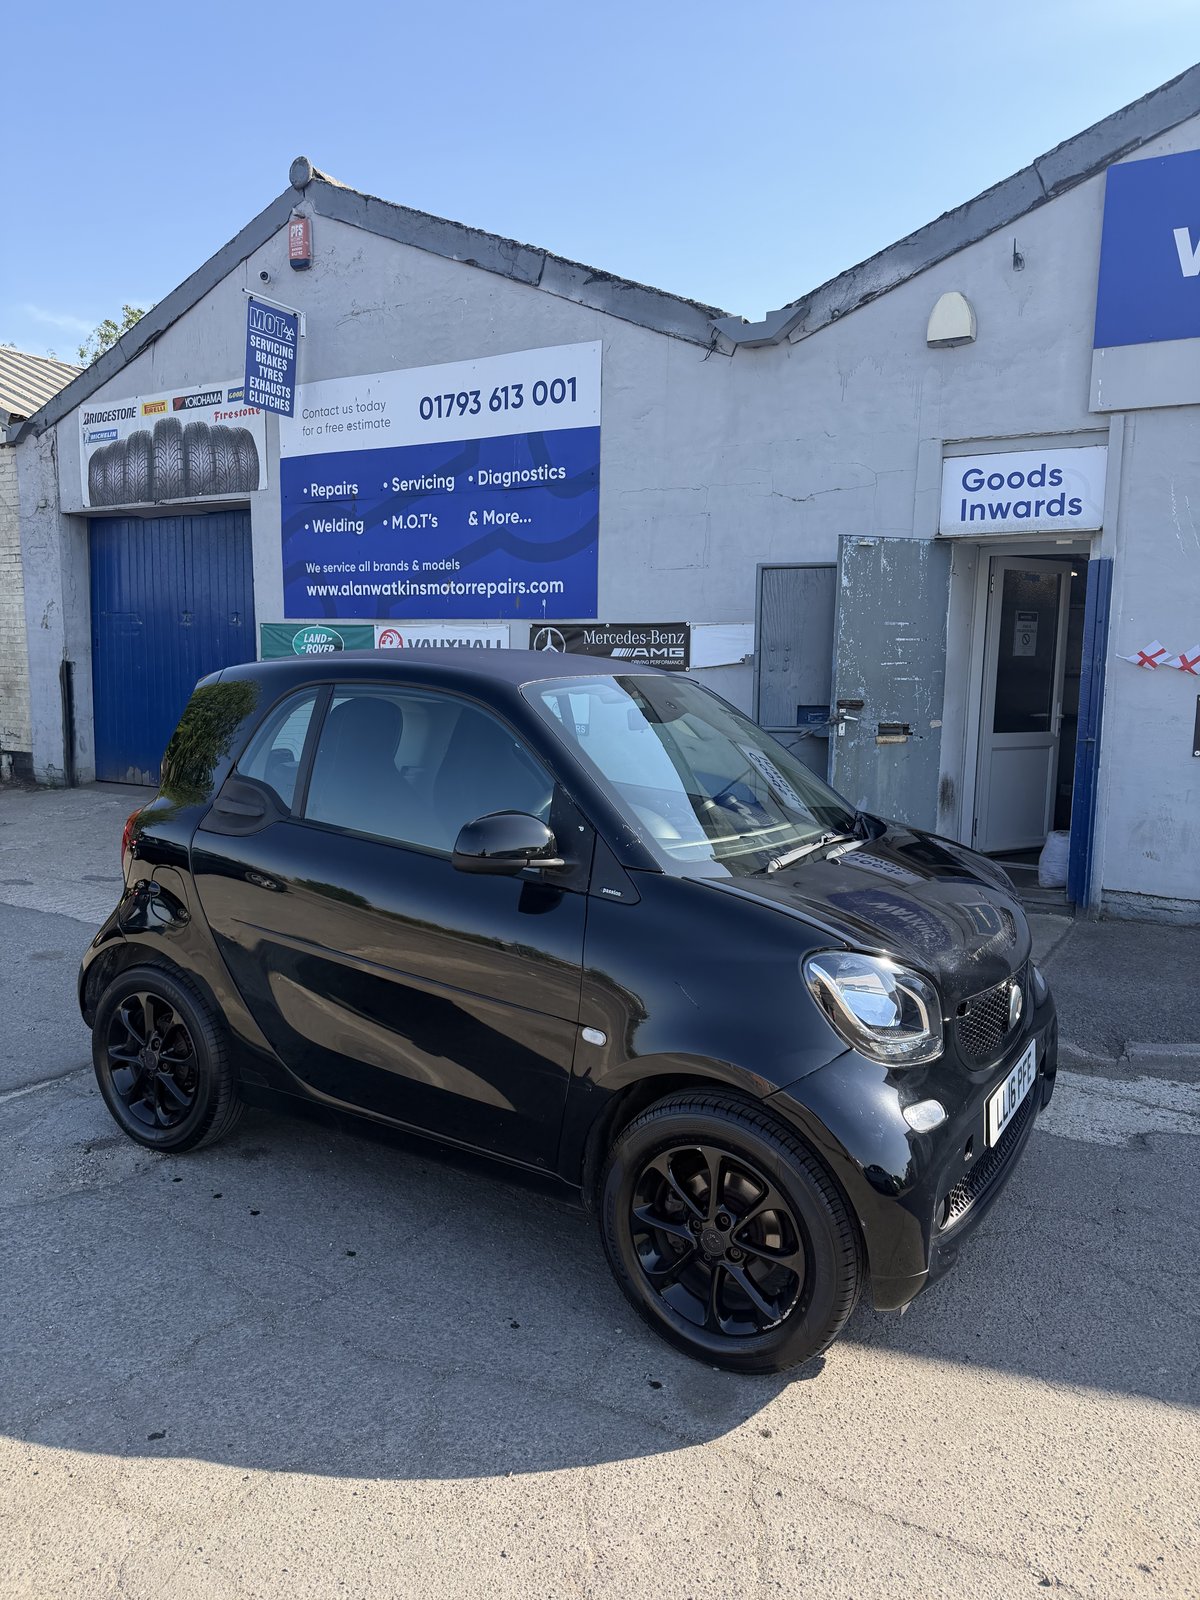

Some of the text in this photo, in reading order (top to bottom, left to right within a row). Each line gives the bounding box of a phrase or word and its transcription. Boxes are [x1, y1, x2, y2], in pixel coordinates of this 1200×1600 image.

[250, 306, 285, 338] MOT
[250, 334, 294, 360] SERVICING
[256, 350, 288, 372] BRAKES
[259, 365, 284, 384] TYRES
[250, 376, 291, 399] EXHAUSTS
[184, 392, 222, 408] YOKOHAMA
[249, 390, 290, 412] CLUTCHES
[419, 376, 578, 420] 01793 613 001
[83, 406, 137, 425] BRIDGESTONE
[213, 407, 261, 423] Firestone
[302, 400, 387, 420] Contact us today
[90, 430, 117, 440] MICHELIN
[302, 418, 391, 437] for a free estimate
[391, 474, 456, 493] Servicing
[478, 464, 567, 487] Diagnostics
[961, 463, 1063, 492] Goods
[310, 481, 359, 500] Repairs
[960, 493, 1083, 522] Inwards
[313, 518, 365, 536] Welding
[468, 511, 479, 526] &
[305, 558, 461, 574] We service all brands & models
[306, 578, 565, 599] www.alanwatkinsmotorrepairs.com
[303, 633, 328, 644] LAND
[583, 629, 685, 645] Mercedes-Benz
[631, 647, 685, 657] AMG
[997, 1051, 1032, 1131] LL16 PFE
